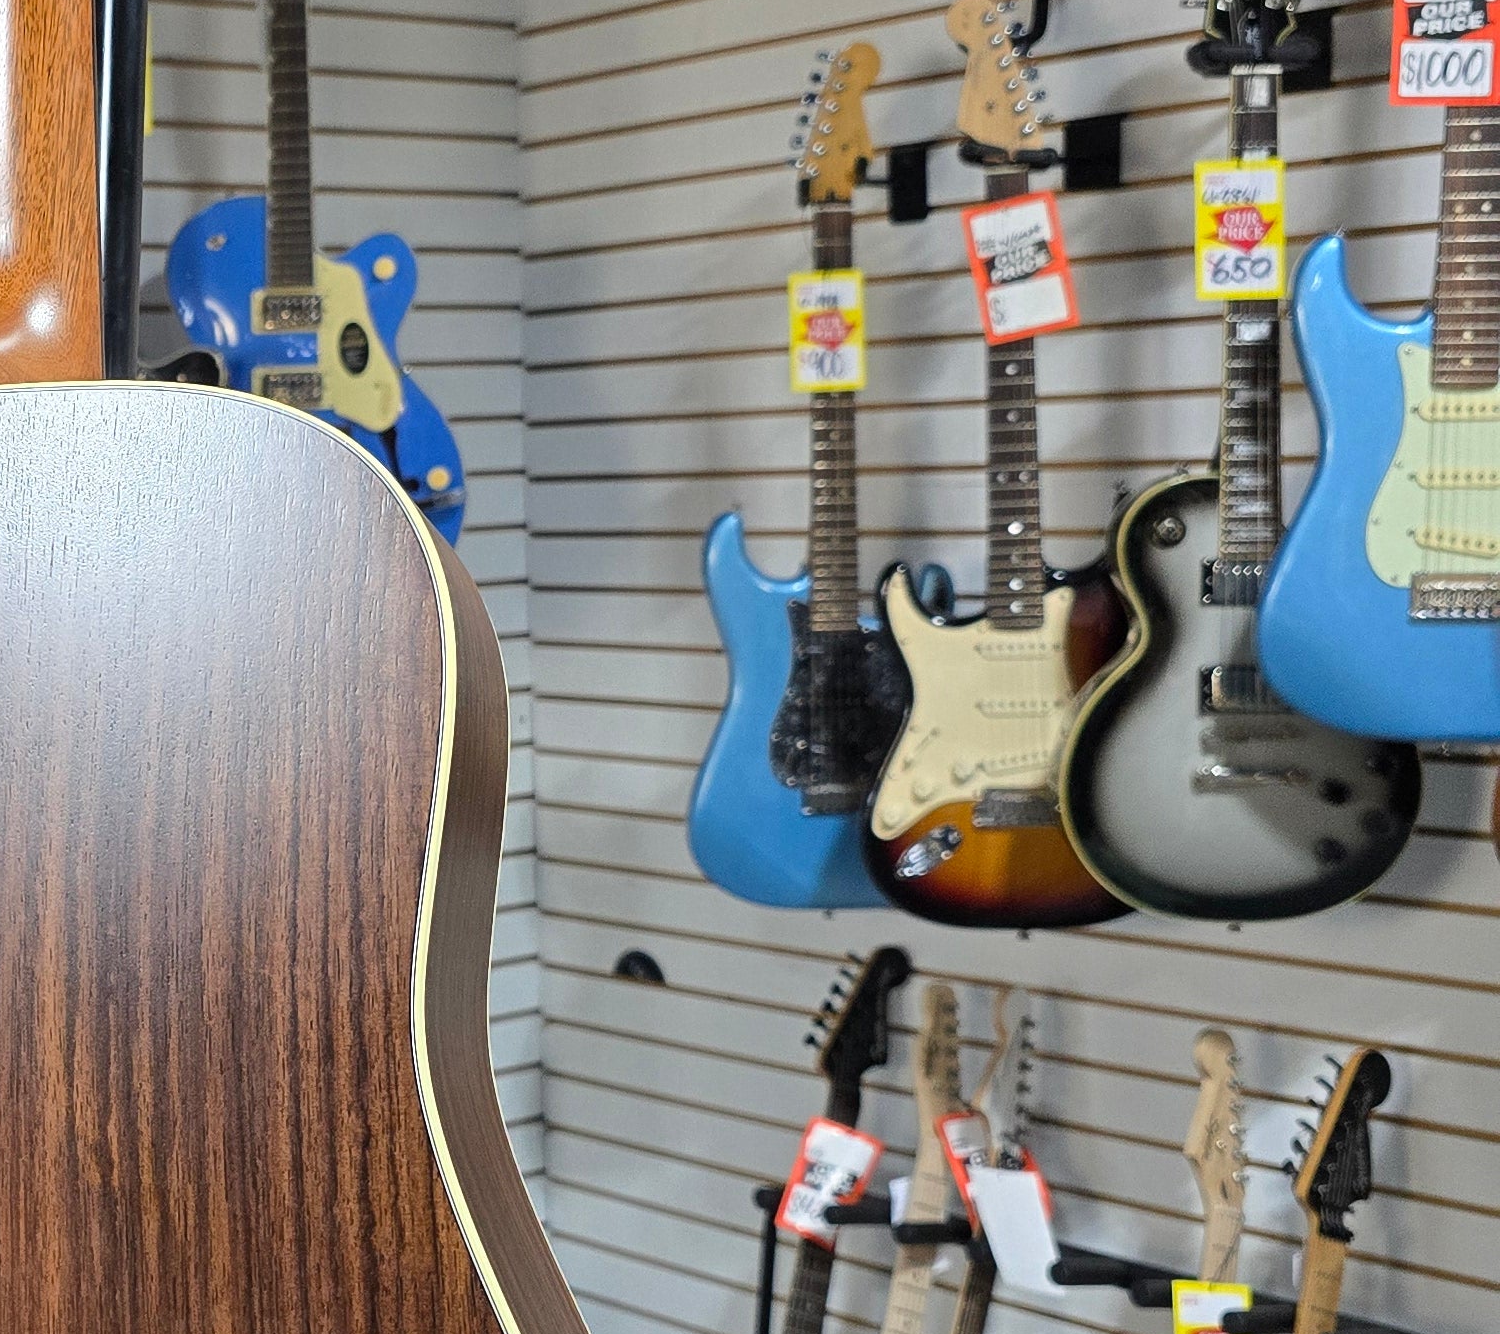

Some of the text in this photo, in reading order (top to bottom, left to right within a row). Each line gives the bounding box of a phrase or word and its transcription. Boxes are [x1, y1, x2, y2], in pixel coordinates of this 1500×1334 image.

[1421, 0, 1472, 19] OUR
[1412, 10, 1485, 36] PRICE
[1402, 48, 1485, 92] $1000
[1223, 210, 1260, 227] OUR
[1218, 224, 1265, 242] PRICE
[990, 251, 1051, 283] PRICE
[994, 245, 1036, 267] OUR
